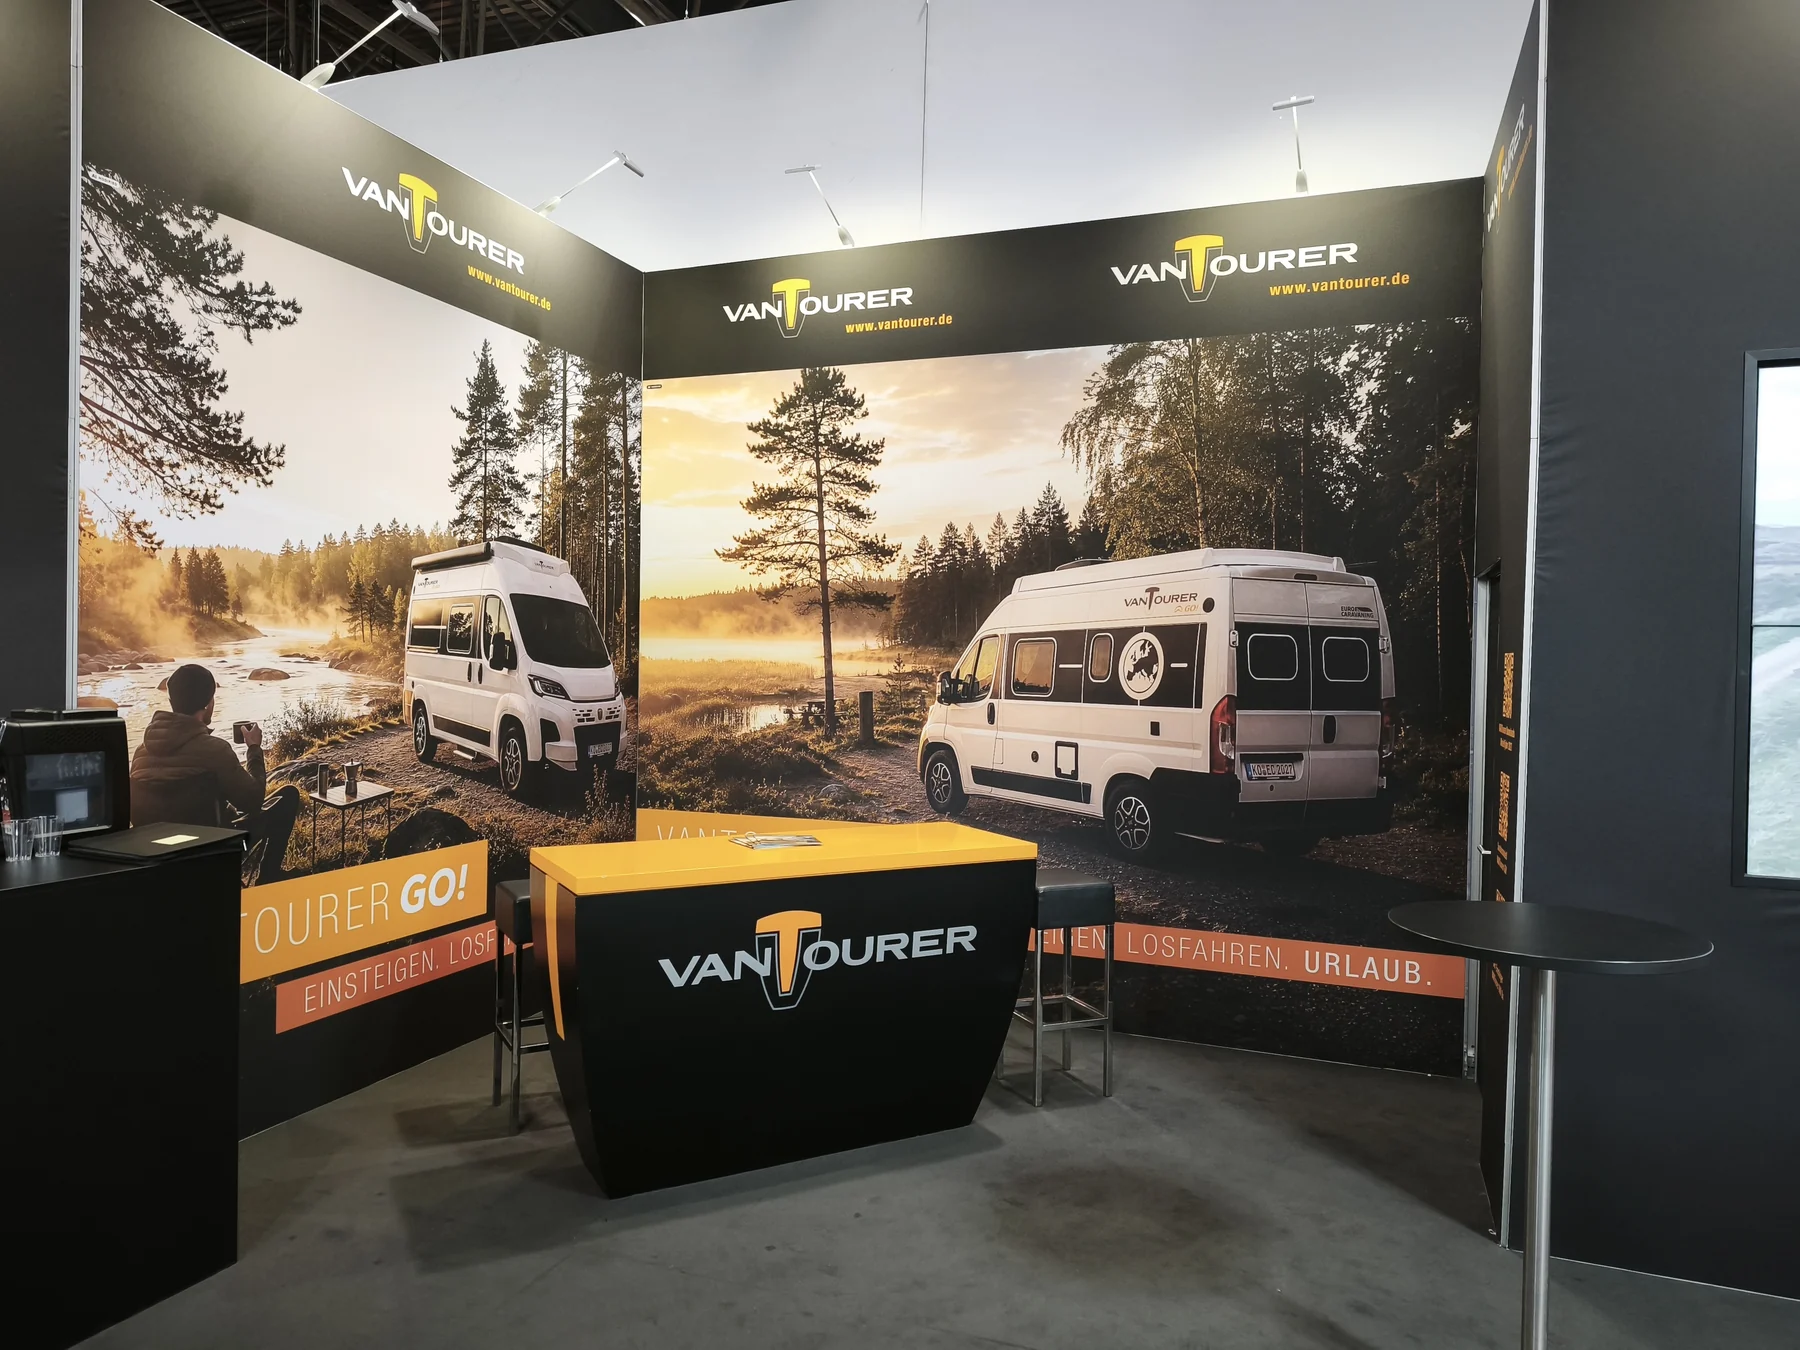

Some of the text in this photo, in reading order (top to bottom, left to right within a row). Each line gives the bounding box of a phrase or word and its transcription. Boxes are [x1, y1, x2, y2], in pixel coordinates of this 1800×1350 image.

[341, 166, 525, 275] VANTOURER
[467, 264, 551, 311] www.vantourer.de
[1110, 234, 1359, 303] VANTOURER
[1269, 272, 1410, 297] www.vantourer.de
[722, 278, 914, 338] VANTOURER
[845, 313, 953, 334] www.vantourer.de
[1124, 586, 1198, 611] VANTOURER
[1340, 611, 1374, 619] CARAVANING
[240, 863, 469, 954] OURER GO!
[304, 948, 440, 1014] EINSTEIGEN.
[658, 910, 979, 1011] VANTOURER
[1127, 931, 1289, 971] LOSFAHREN.
[1304, 950, 1433, 986] URLAUB.
